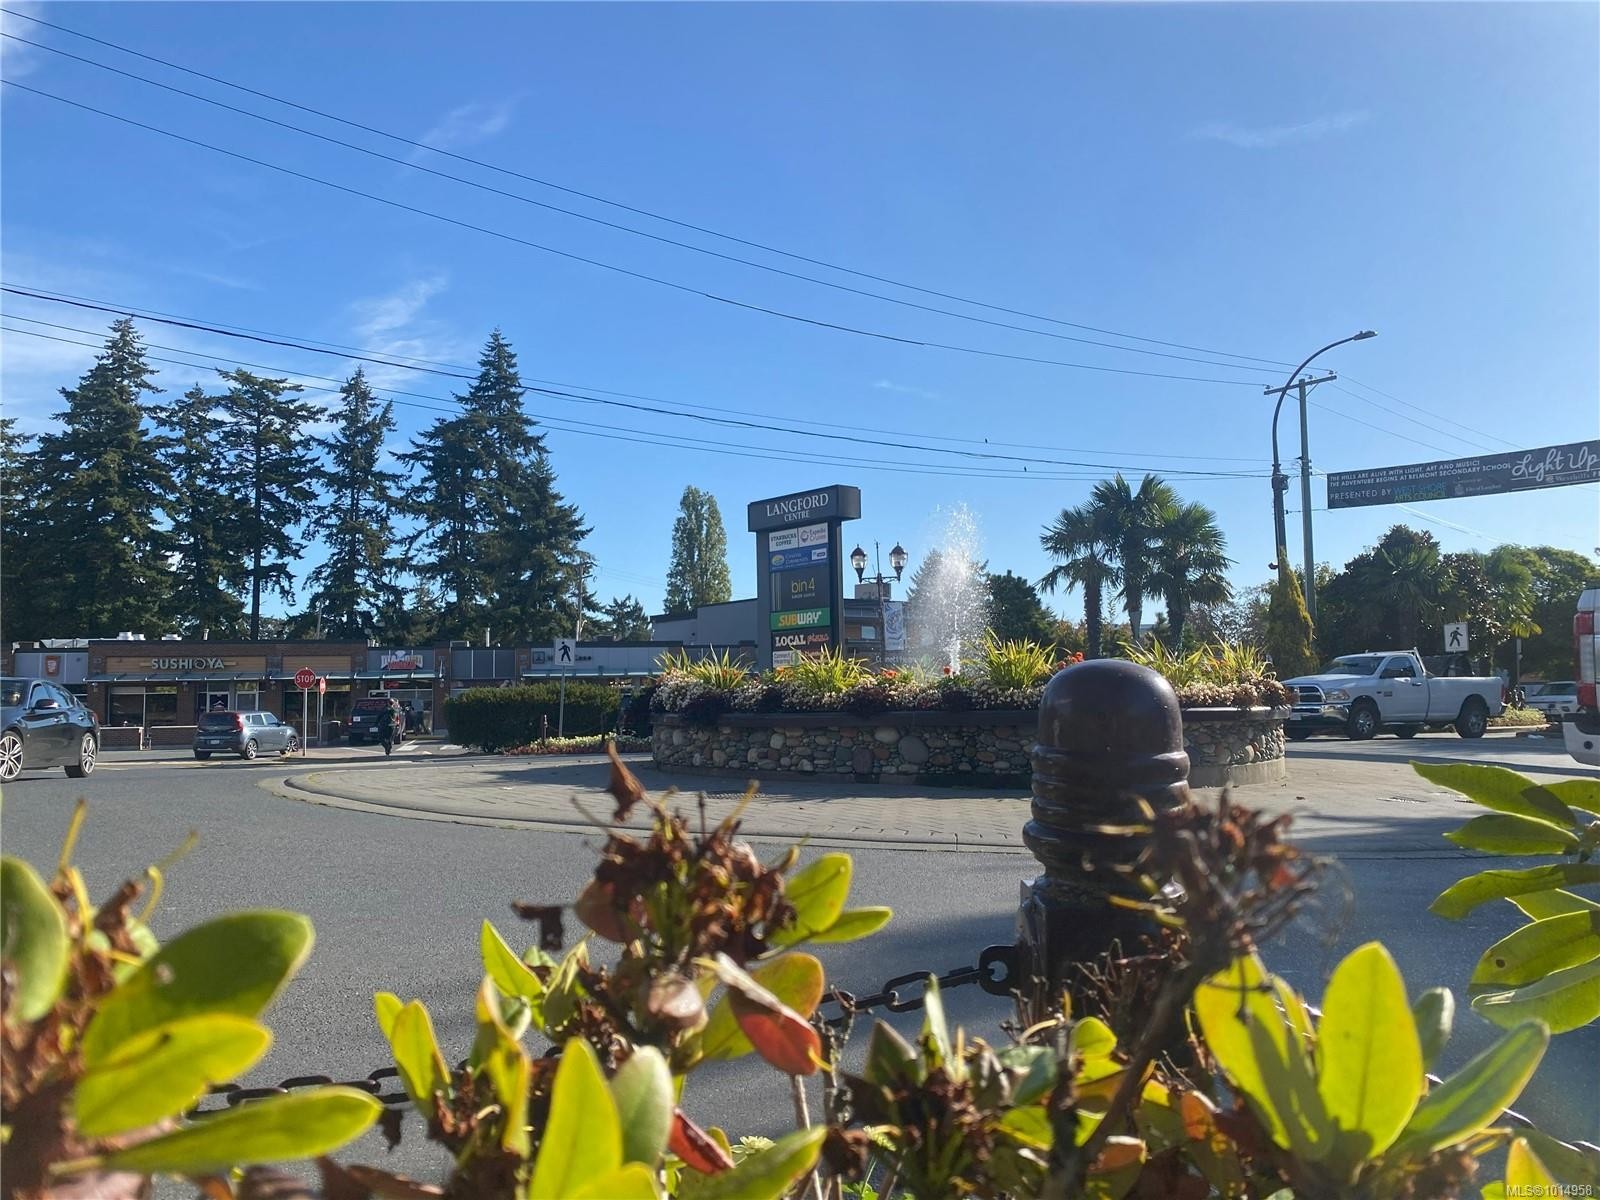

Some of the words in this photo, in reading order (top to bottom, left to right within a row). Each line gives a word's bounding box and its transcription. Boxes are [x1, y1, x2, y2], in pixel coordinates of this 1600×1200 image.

[1511, 448, 1565, 482] Light
[1567, 445, 1600, 472] Up
[1341, 478, 1375, 486] ADVENTURE
[1439, 466, 1480, 476] SECONDARY
[1482, 462, 1511, 471] SCHOOL
[1370, 470, 1387, 478] ALIVE
[1330, 490, 1378, 500] PRESENTED
[1381, 488, 1392, 496] BY
[767, 493, 829, 517] LANGFORD
[784, 510, 810, 522] CENTRE
[778, 611, 821, 627] SUBWAY
[775, 634, 806, 647] LOCAL
[296, 674, 315, 684] STOP
